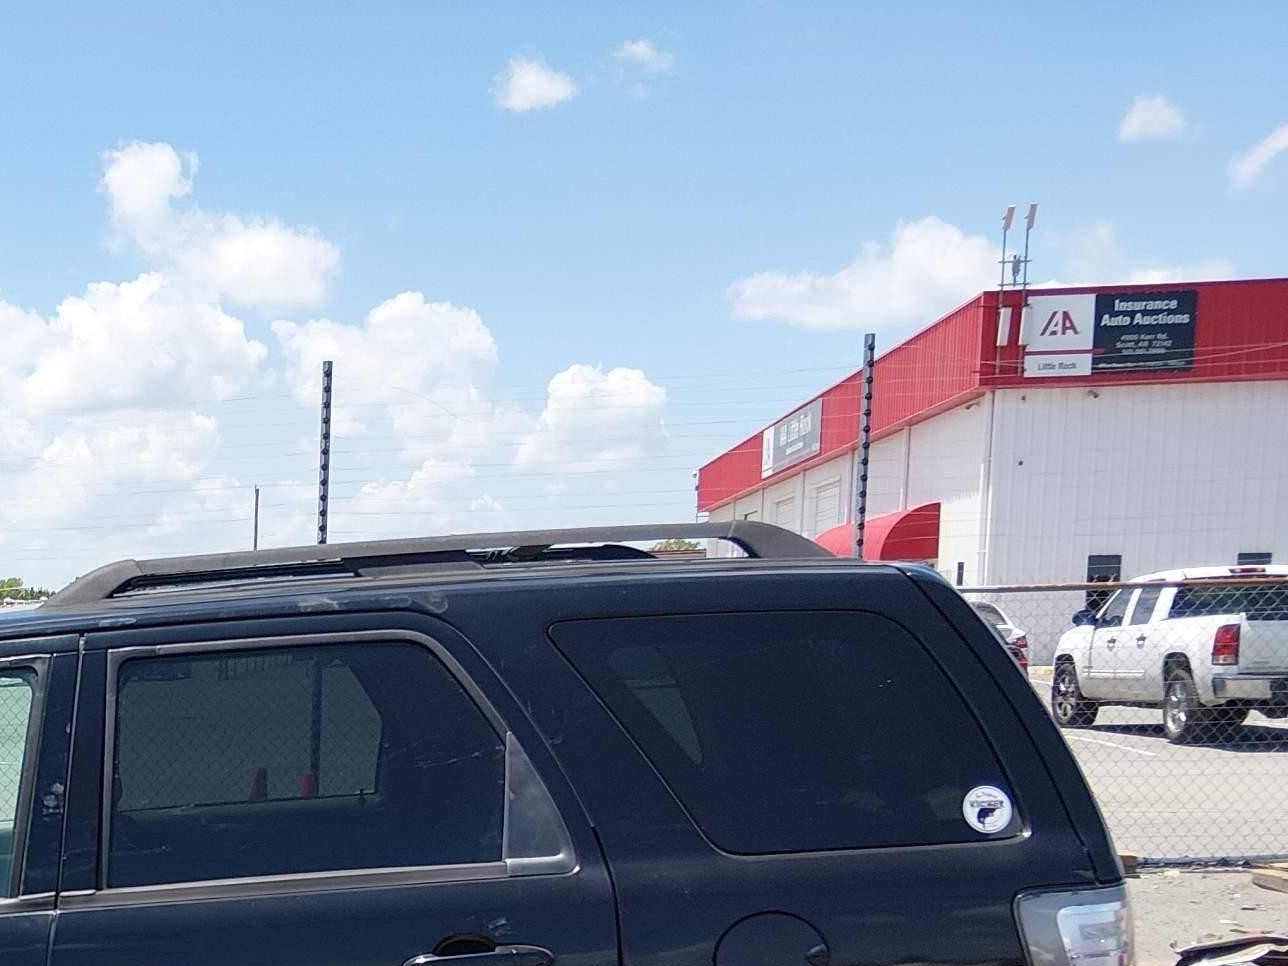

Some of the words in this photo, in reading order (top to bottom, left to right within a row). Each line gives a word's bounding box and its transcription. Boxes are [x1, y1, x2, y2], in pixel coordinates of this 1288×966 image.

[1114, 298, 1178, 311] Insurance
[1100, 314, 1130, 327] Auto
[1132, 311, 1191, 326] Auctions
[1037, 362, 1057, 371] Little
[1058, 361, 1077, 370] Rock
